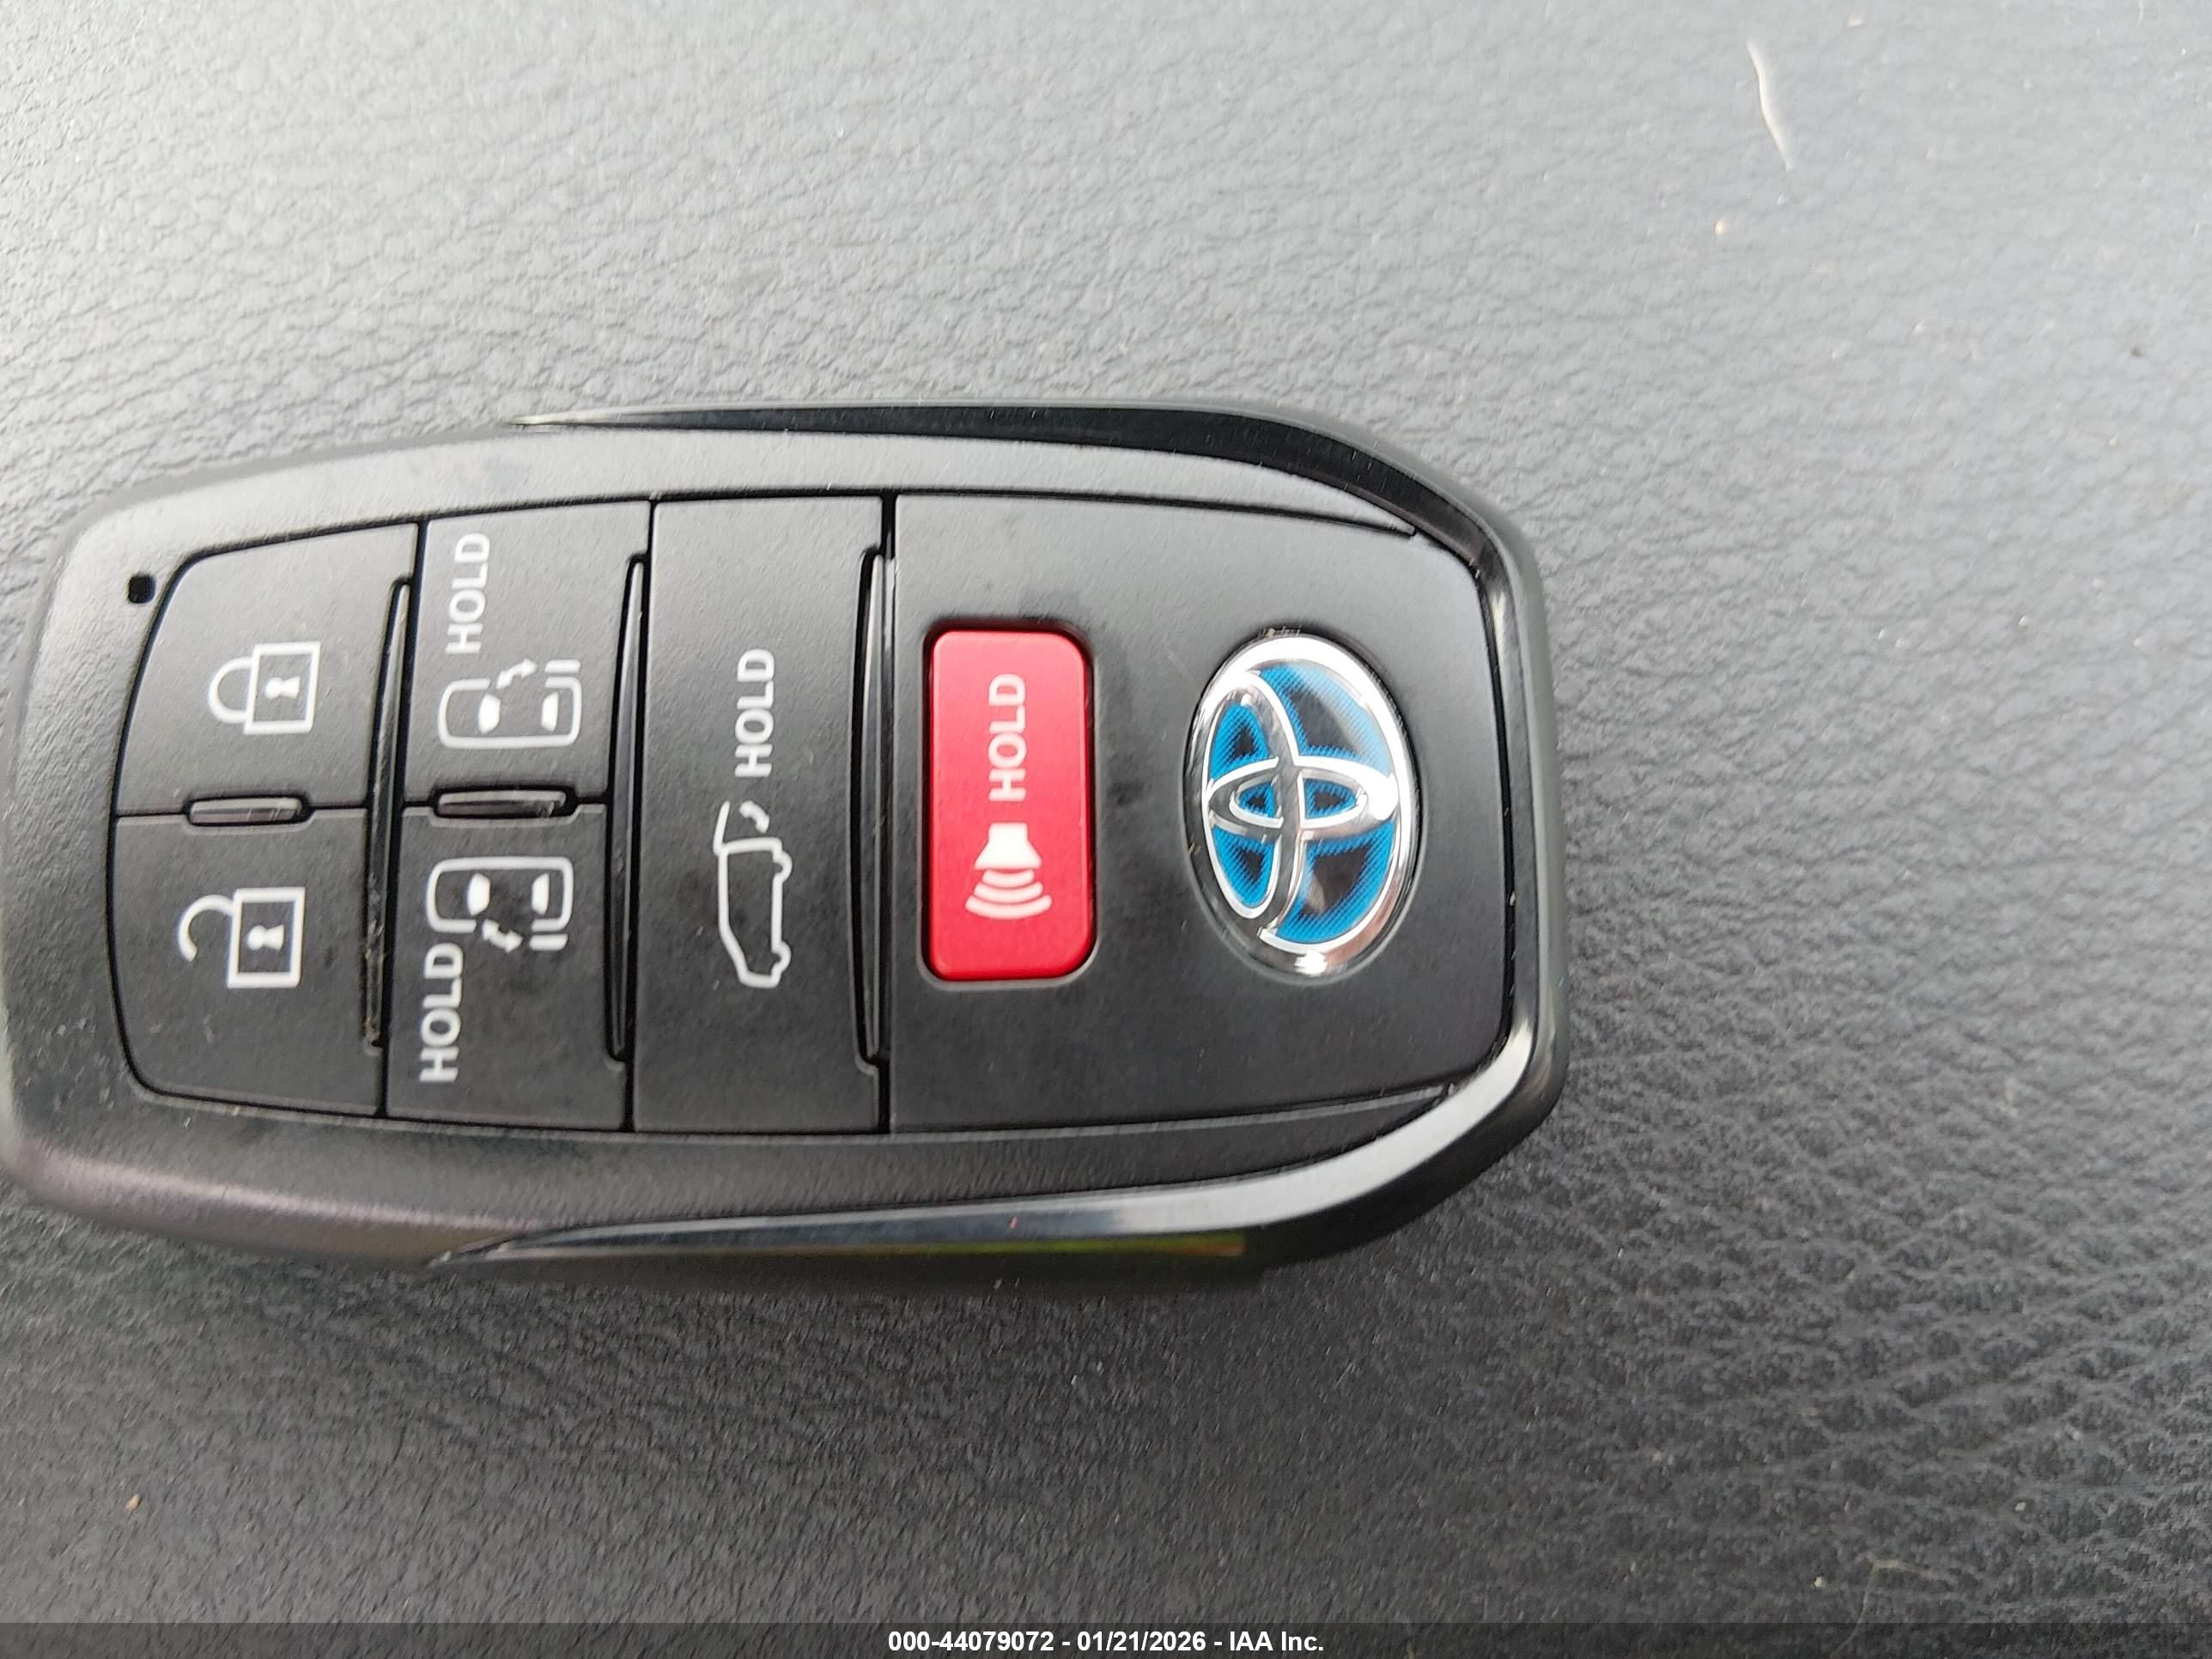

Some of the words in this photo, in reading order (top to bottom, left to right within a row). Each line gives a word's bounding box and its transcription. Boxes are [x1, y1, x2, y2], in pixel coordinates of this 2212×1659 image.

[446, 532, 491, 654] HOLD
[735, 648, 778, 779] HOLD
[988, 673, 1027, 803] HOLD
[419, 943, 464, 1083] HOLD
